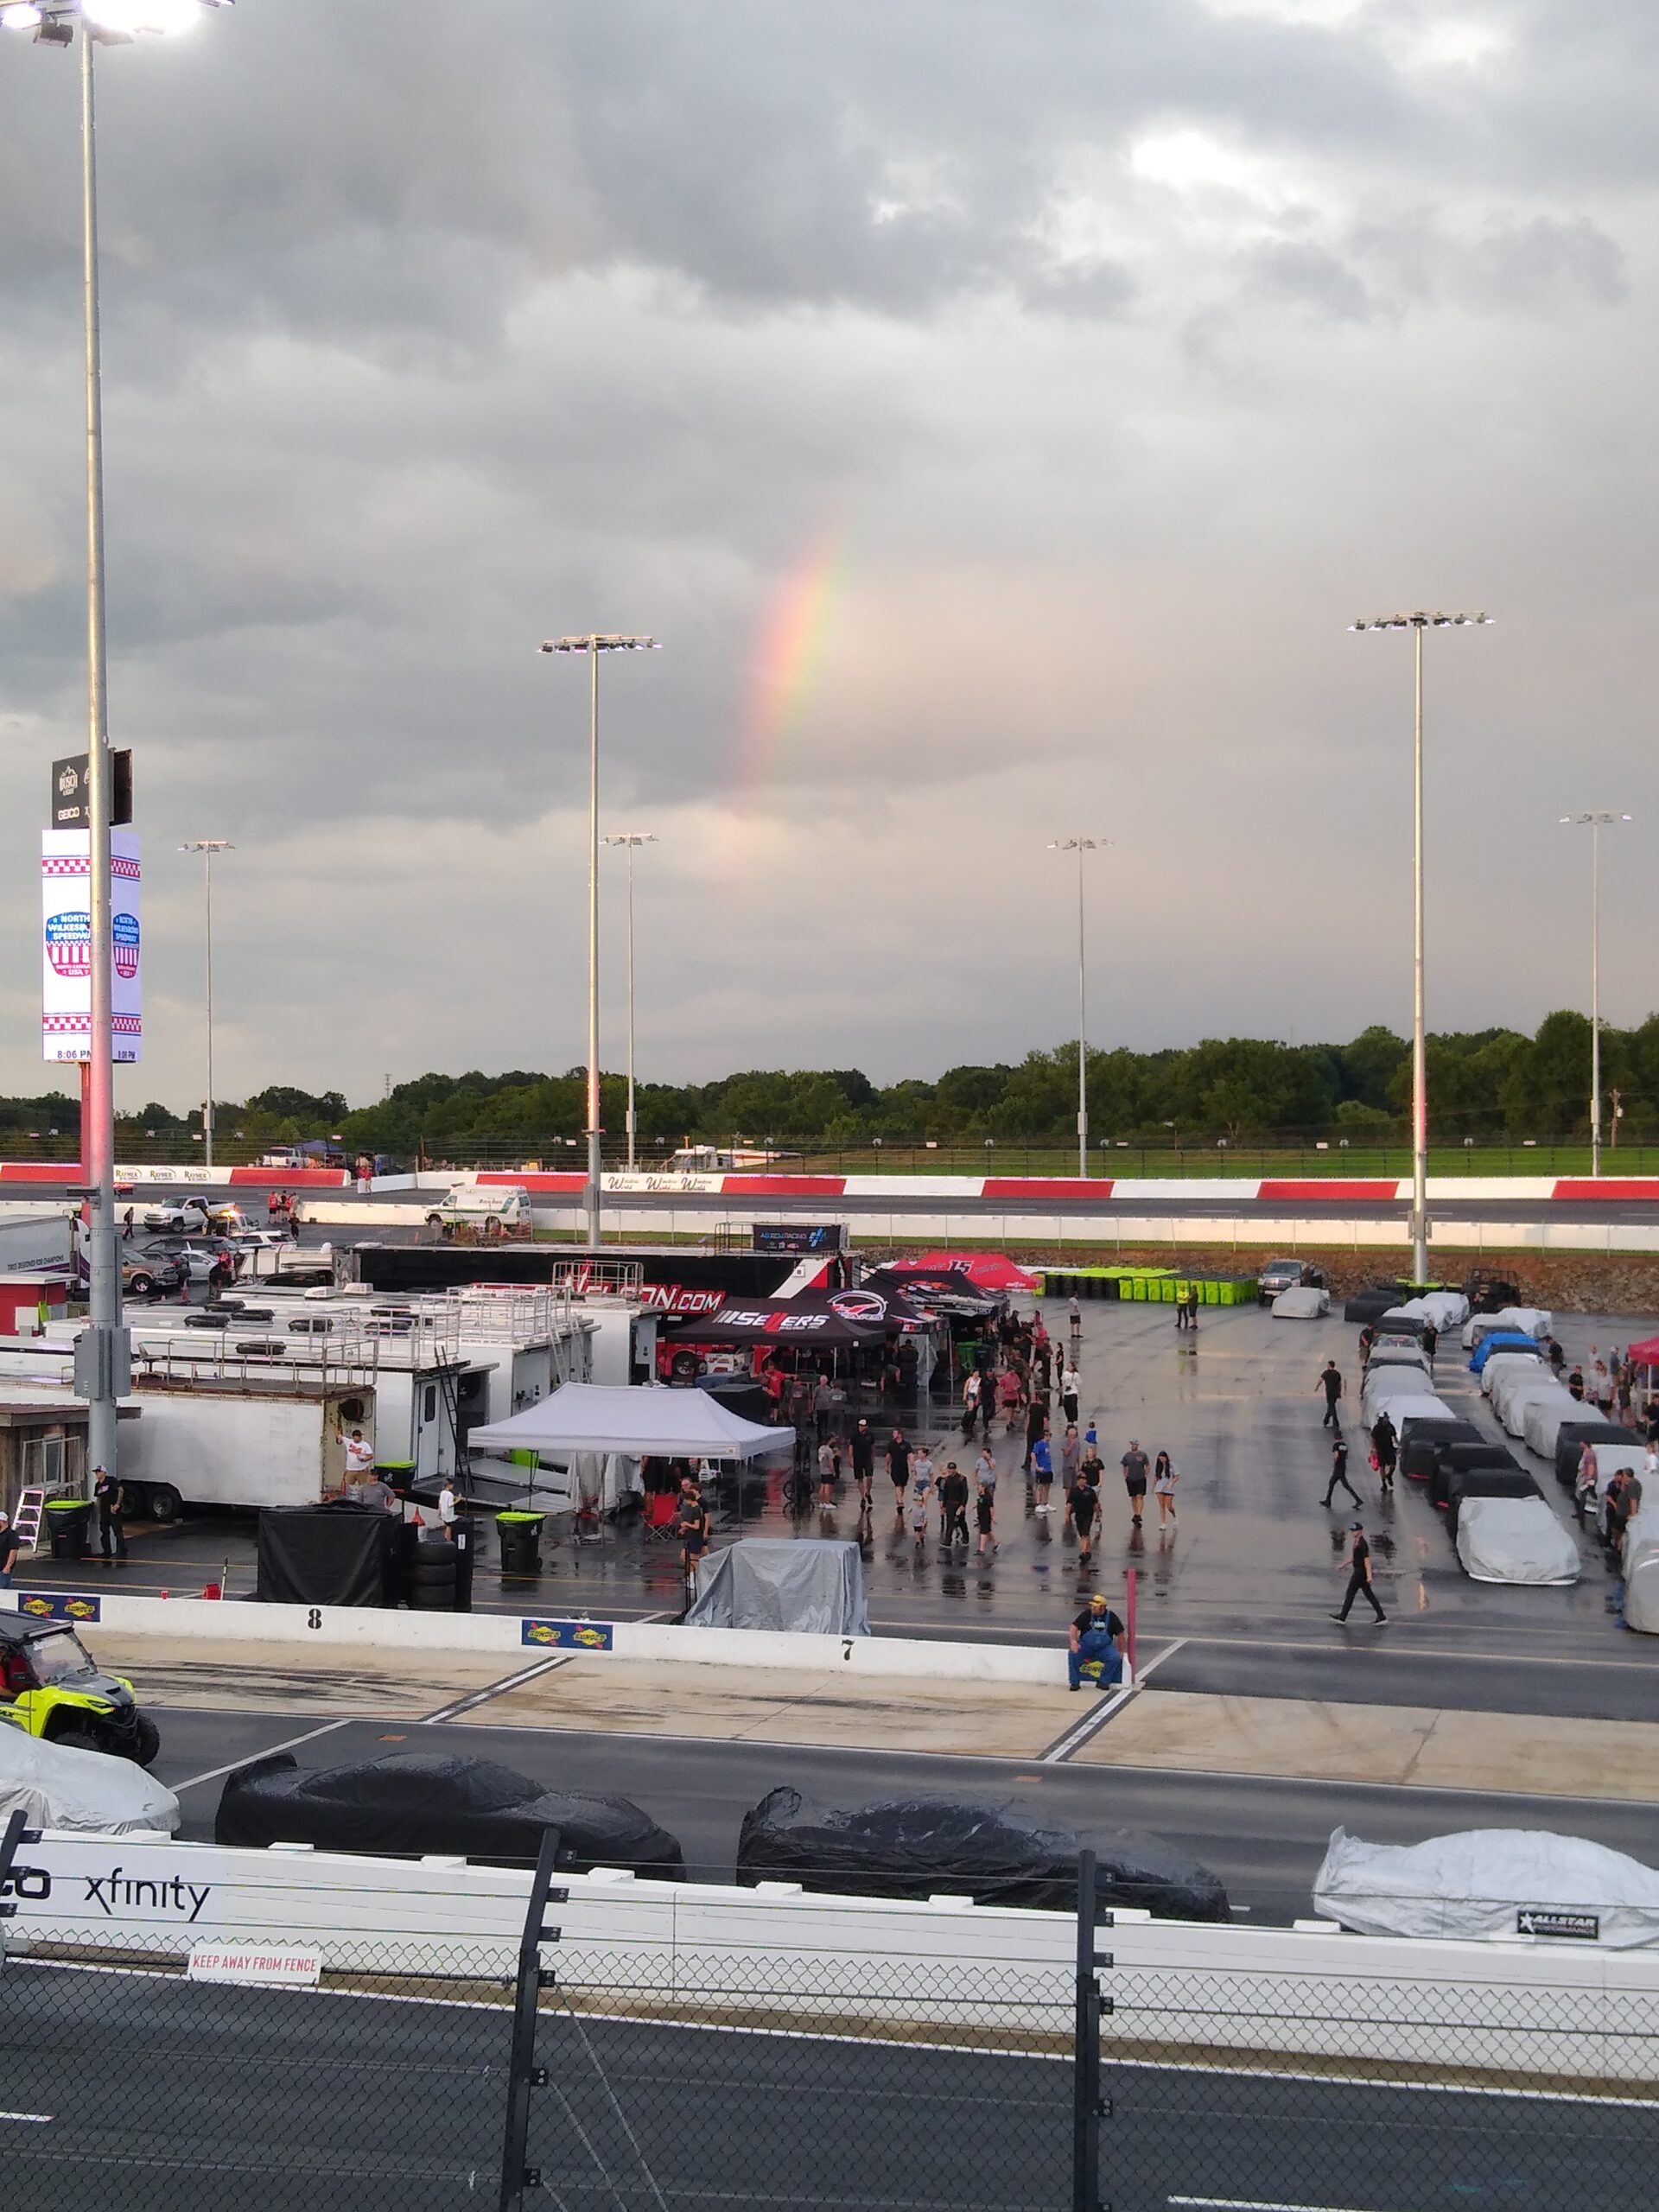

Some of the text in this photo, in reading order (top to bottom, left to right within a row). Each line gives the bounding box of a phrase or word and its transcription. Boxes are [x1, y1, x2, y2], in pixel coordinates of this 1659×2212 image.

[58, 807, 79, 821] GEICO
[57, 1050, 77, 1058] 8:06
[950, 1260, 974, 1274] 15
[308, 1608, 322, 1630] 8
[528, 1630, 607, 1642] SUNOCO SUNOCO
[842, 1639, 855, 1661] 7
[1080, 1664, 1101, 1673] SUN
[85, 1867, 211, 1922] xfinity
[1533, 1915, 1595, 1927] ALLSTAR
[193, 1955, 318, 1973] KEEP AWAY FROM FENCE
